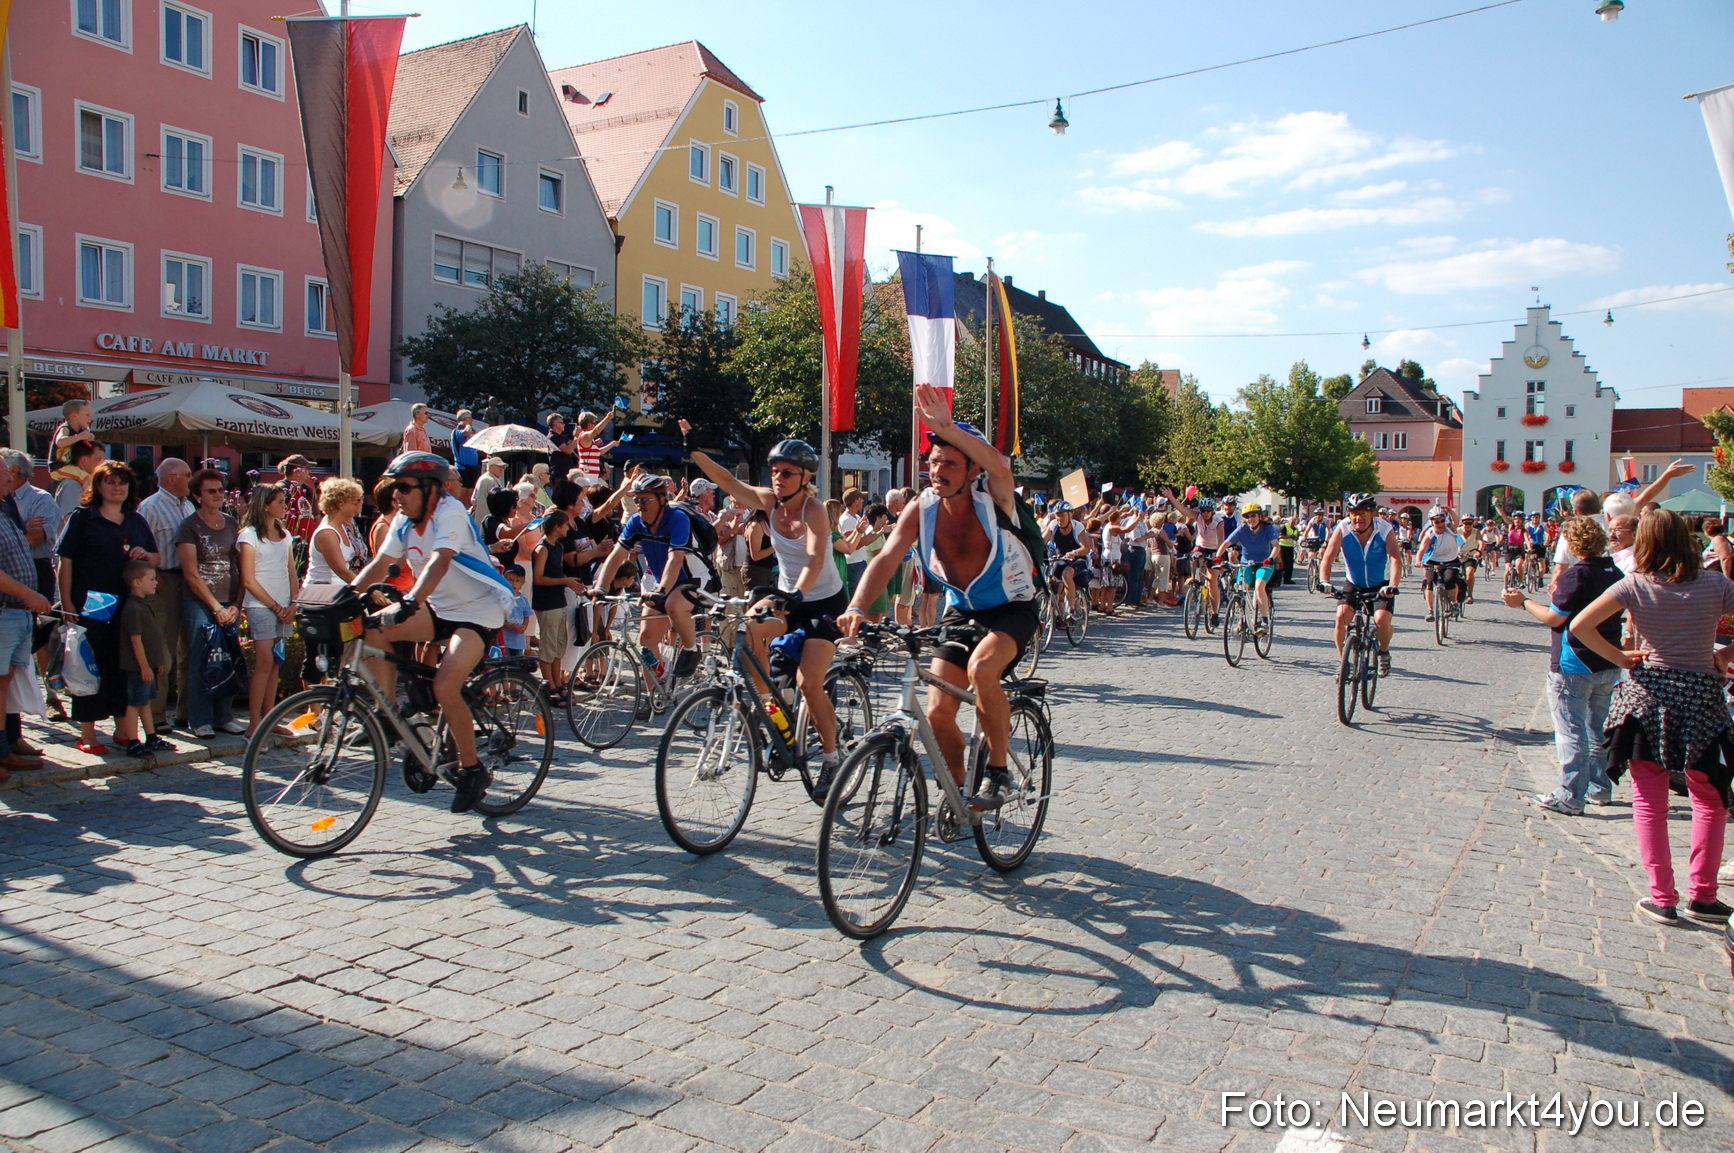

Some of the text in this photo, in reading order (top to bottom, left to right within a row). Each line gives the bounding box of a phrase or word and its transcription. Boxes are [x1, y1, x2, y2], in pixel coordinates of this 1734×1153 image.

[96, 332, 270, 366] CAFE AM MARKT
[33, 362, 86, 376] BECK'S
[147, 373, 233, 387] CAFE AM RKT
[289, 385, 326, 397] BECK'S
[28, 415, 148, 432] Franzisr Weissbier
[215, 417, 360, 441] Franziskaner Weissr
[1390, 497, 1430, 505] Sparkasse
